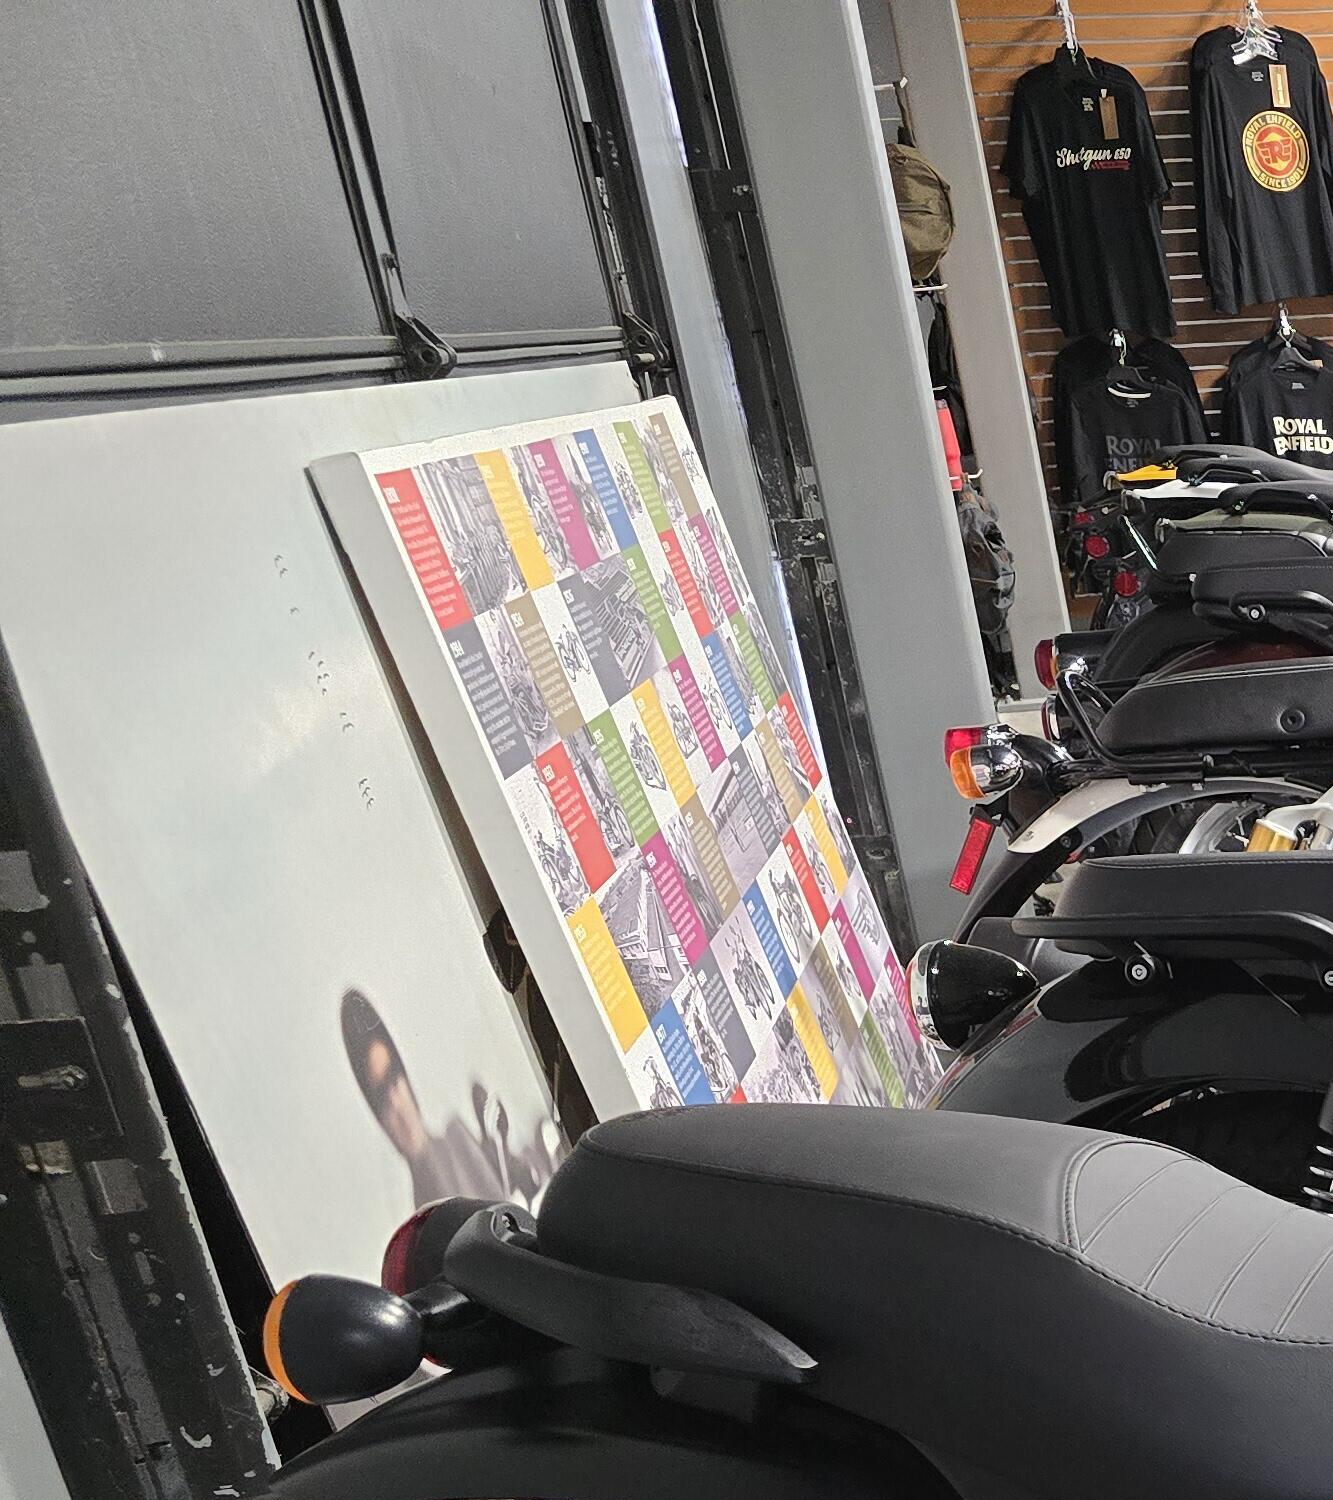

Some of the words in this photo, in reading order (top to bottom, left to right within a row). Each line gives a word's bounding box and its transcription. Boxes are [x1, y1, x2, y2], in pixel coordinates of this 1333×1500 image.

[1266, 114, 1302, 140] ENFIELD
[1056, 146, 1112, 171] Shotgun
[1114, 147, 1131, 160] 650
[1260, 171, 1288, 188] SINCE
[1272, 416, 1328, 436] ROYAL
